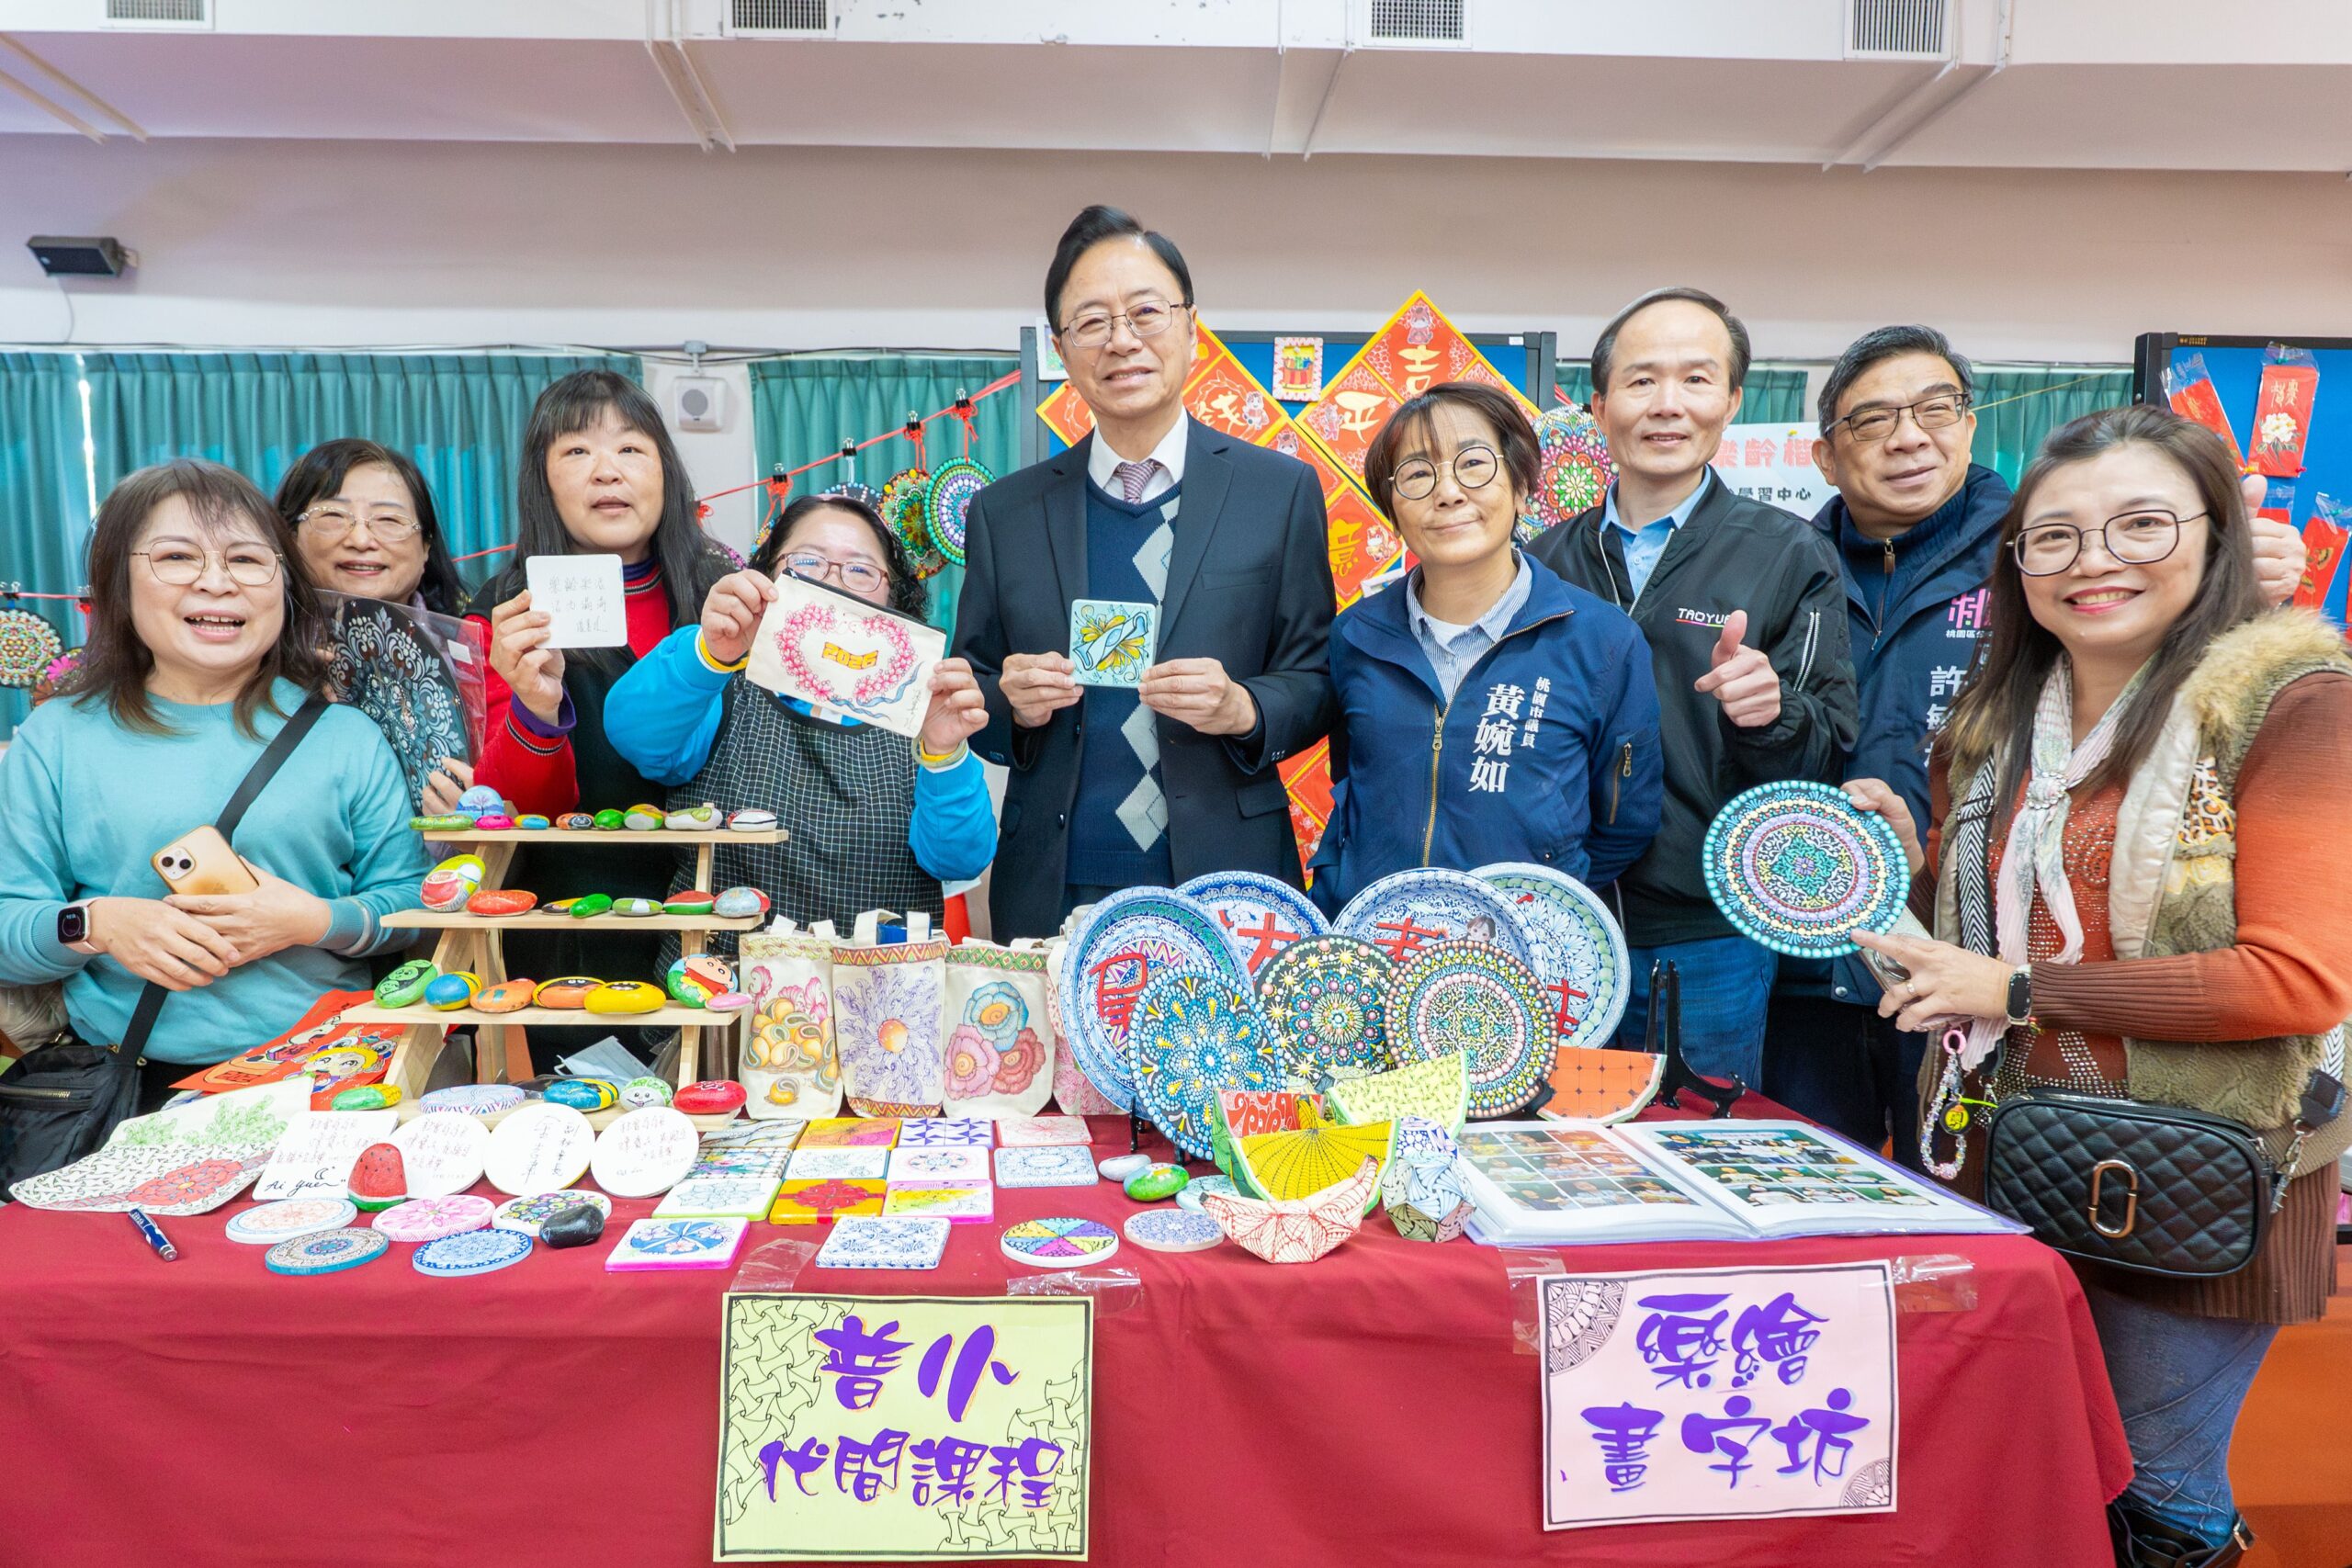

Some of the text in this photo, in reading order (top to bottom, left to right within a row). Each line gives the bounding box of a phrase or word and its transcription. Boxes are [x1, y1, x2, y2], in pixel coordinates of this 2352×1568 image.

[1397, 344, 1442, 395] 吉
[1729, 486, 1812, 502] 學習中心
[822, 641, 879, 671] 2026
[1468, 682, 1526, 793] 黃婉如
[1521, 676, 1552, 749] 桃園市議員
[759, 1428, 1064, 1508] 代間課程
[1580, 1388, 1871, 1493] 畫字坊
